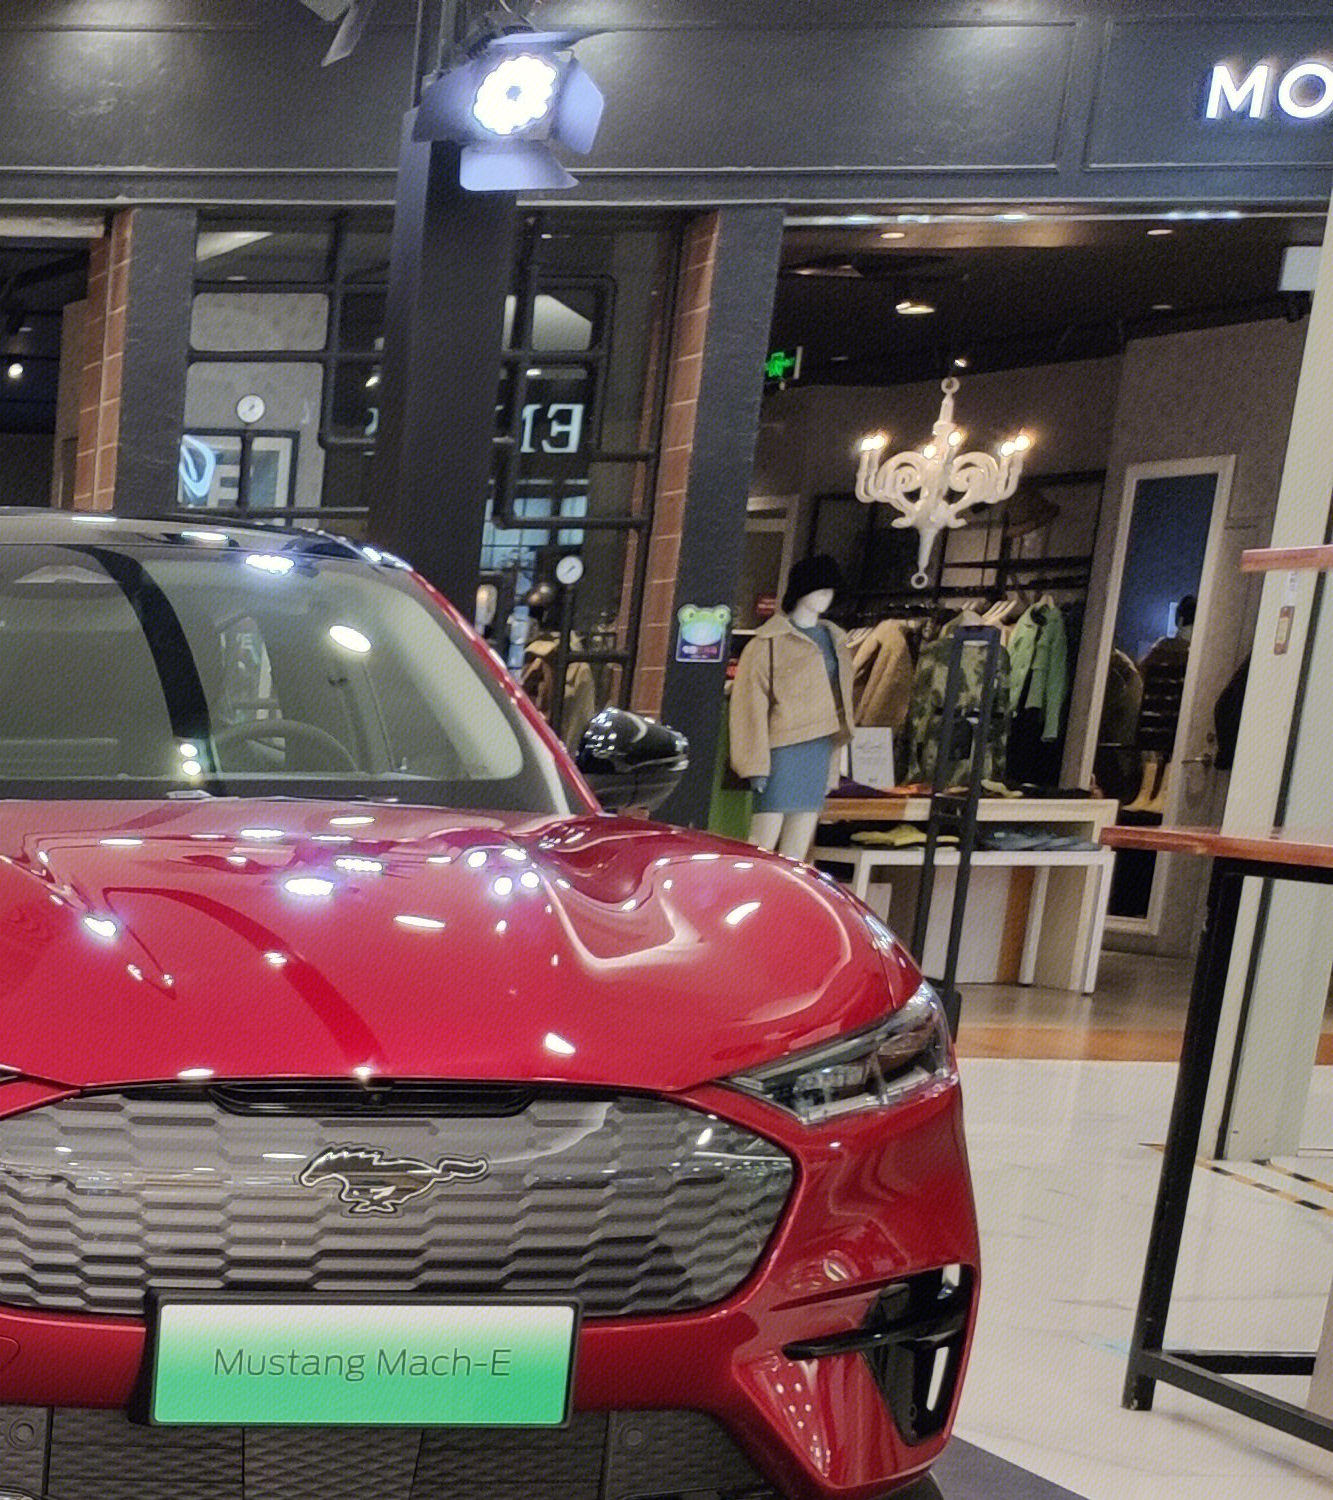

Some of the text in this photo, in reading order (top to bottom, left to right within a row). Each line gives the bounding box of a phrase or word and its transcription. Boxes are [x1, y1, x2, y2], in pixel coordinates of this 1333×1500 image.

[1205, 63, 1333, 119] MO
[213, 1347, 512, 1383] Mustang Mach-E
